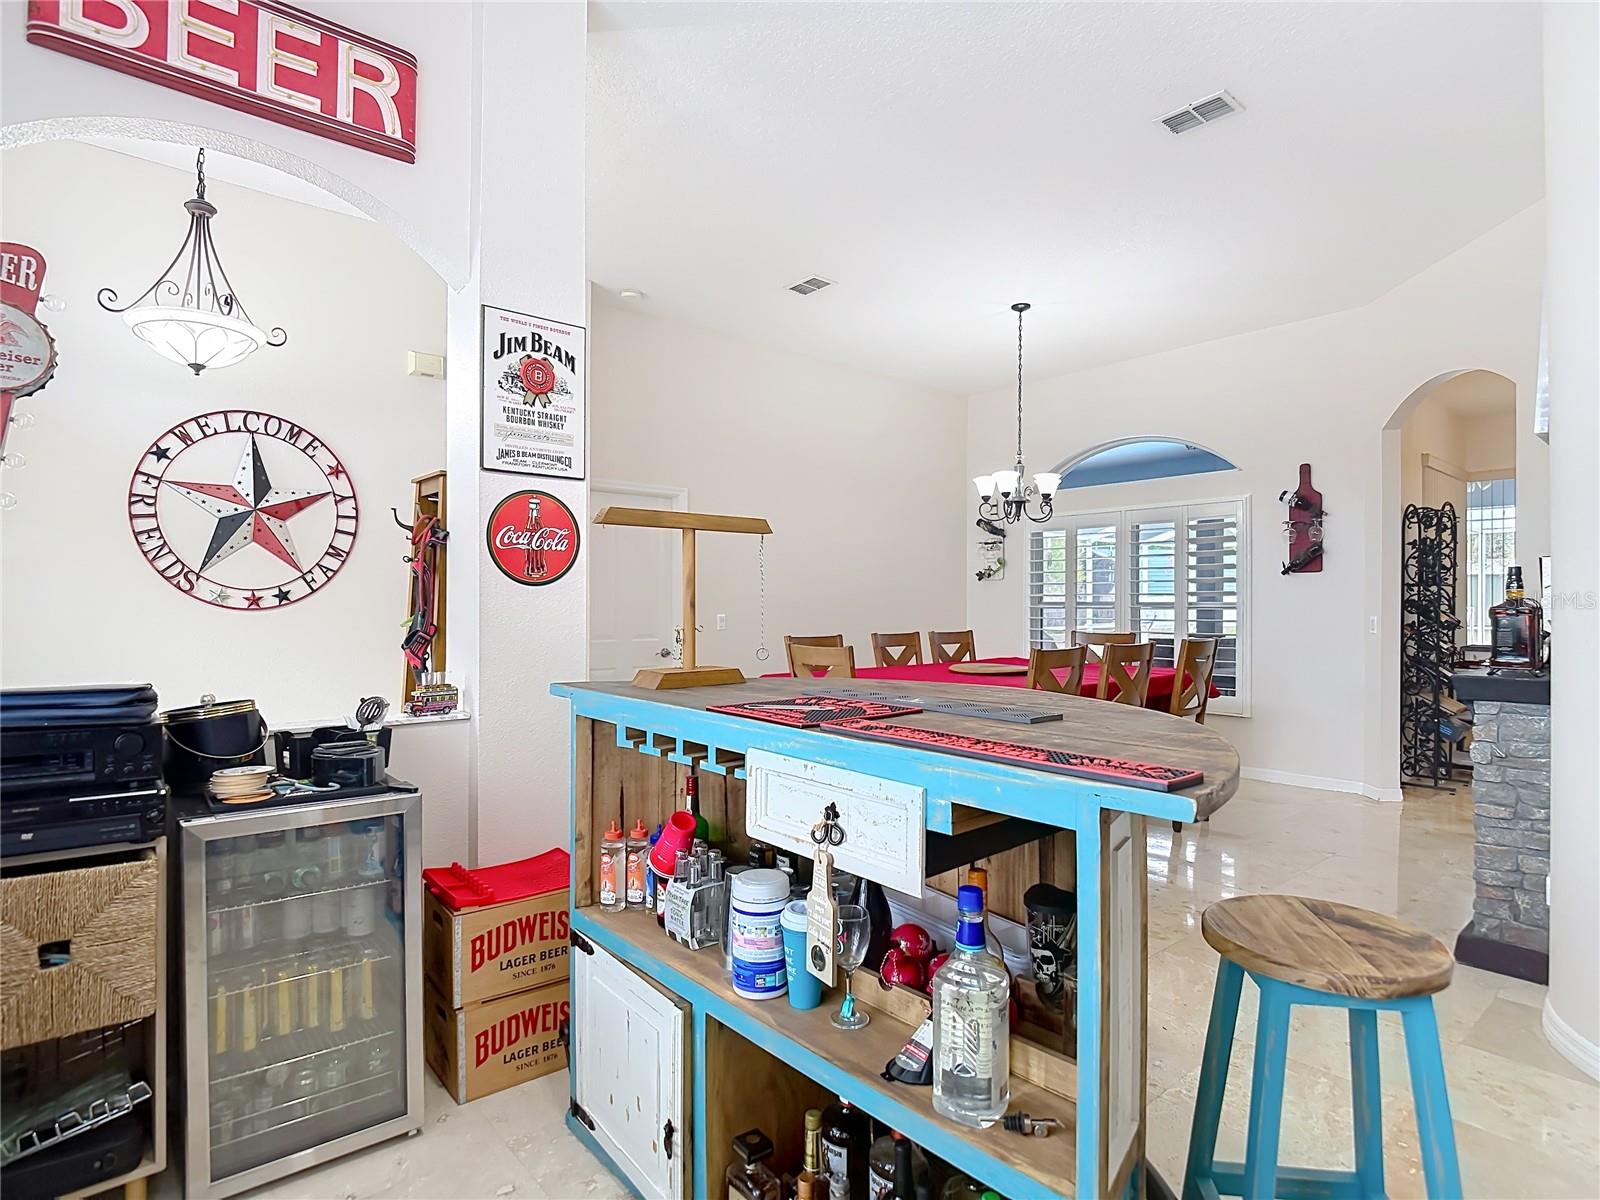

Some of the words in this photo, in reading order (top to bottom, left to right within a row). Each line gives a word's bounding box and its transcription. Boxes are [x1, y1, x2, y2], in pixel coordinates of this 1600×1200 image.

[59, 0, 402, 139] BEER
[493, 331, 527, 360] JIM
[530, 331, 576, 375] BEAM
[503, 405, 536, 418] KENTUCKY
[537, 411, 567, 423] STRAIGHT
[506, 415, 536, 426] BOURBON
[538, 419, 565, 431] WHISKEY
[171, 411, 323, 458] WELCOME
[495, 448, 516, 460] JAMES
[521, 451, 537, 459] BEAM
[537, 453, 564, 465] DISTILLING
[130, 469, 201, 594] FRIENDS
[301, 491, 359, 593] FAMILY
[470, 910, 569, 974] BUDWEIS
[500, 953, 536, 971] LAGER
[540, 945, 568, 961] BEER
[512, 967, 538, 980] SINCE
[503, 1046, 539, 1064] LAGER
[542, 1038, 564, 1053] BEE
[516, 1059, 540, 1072] SINCE
